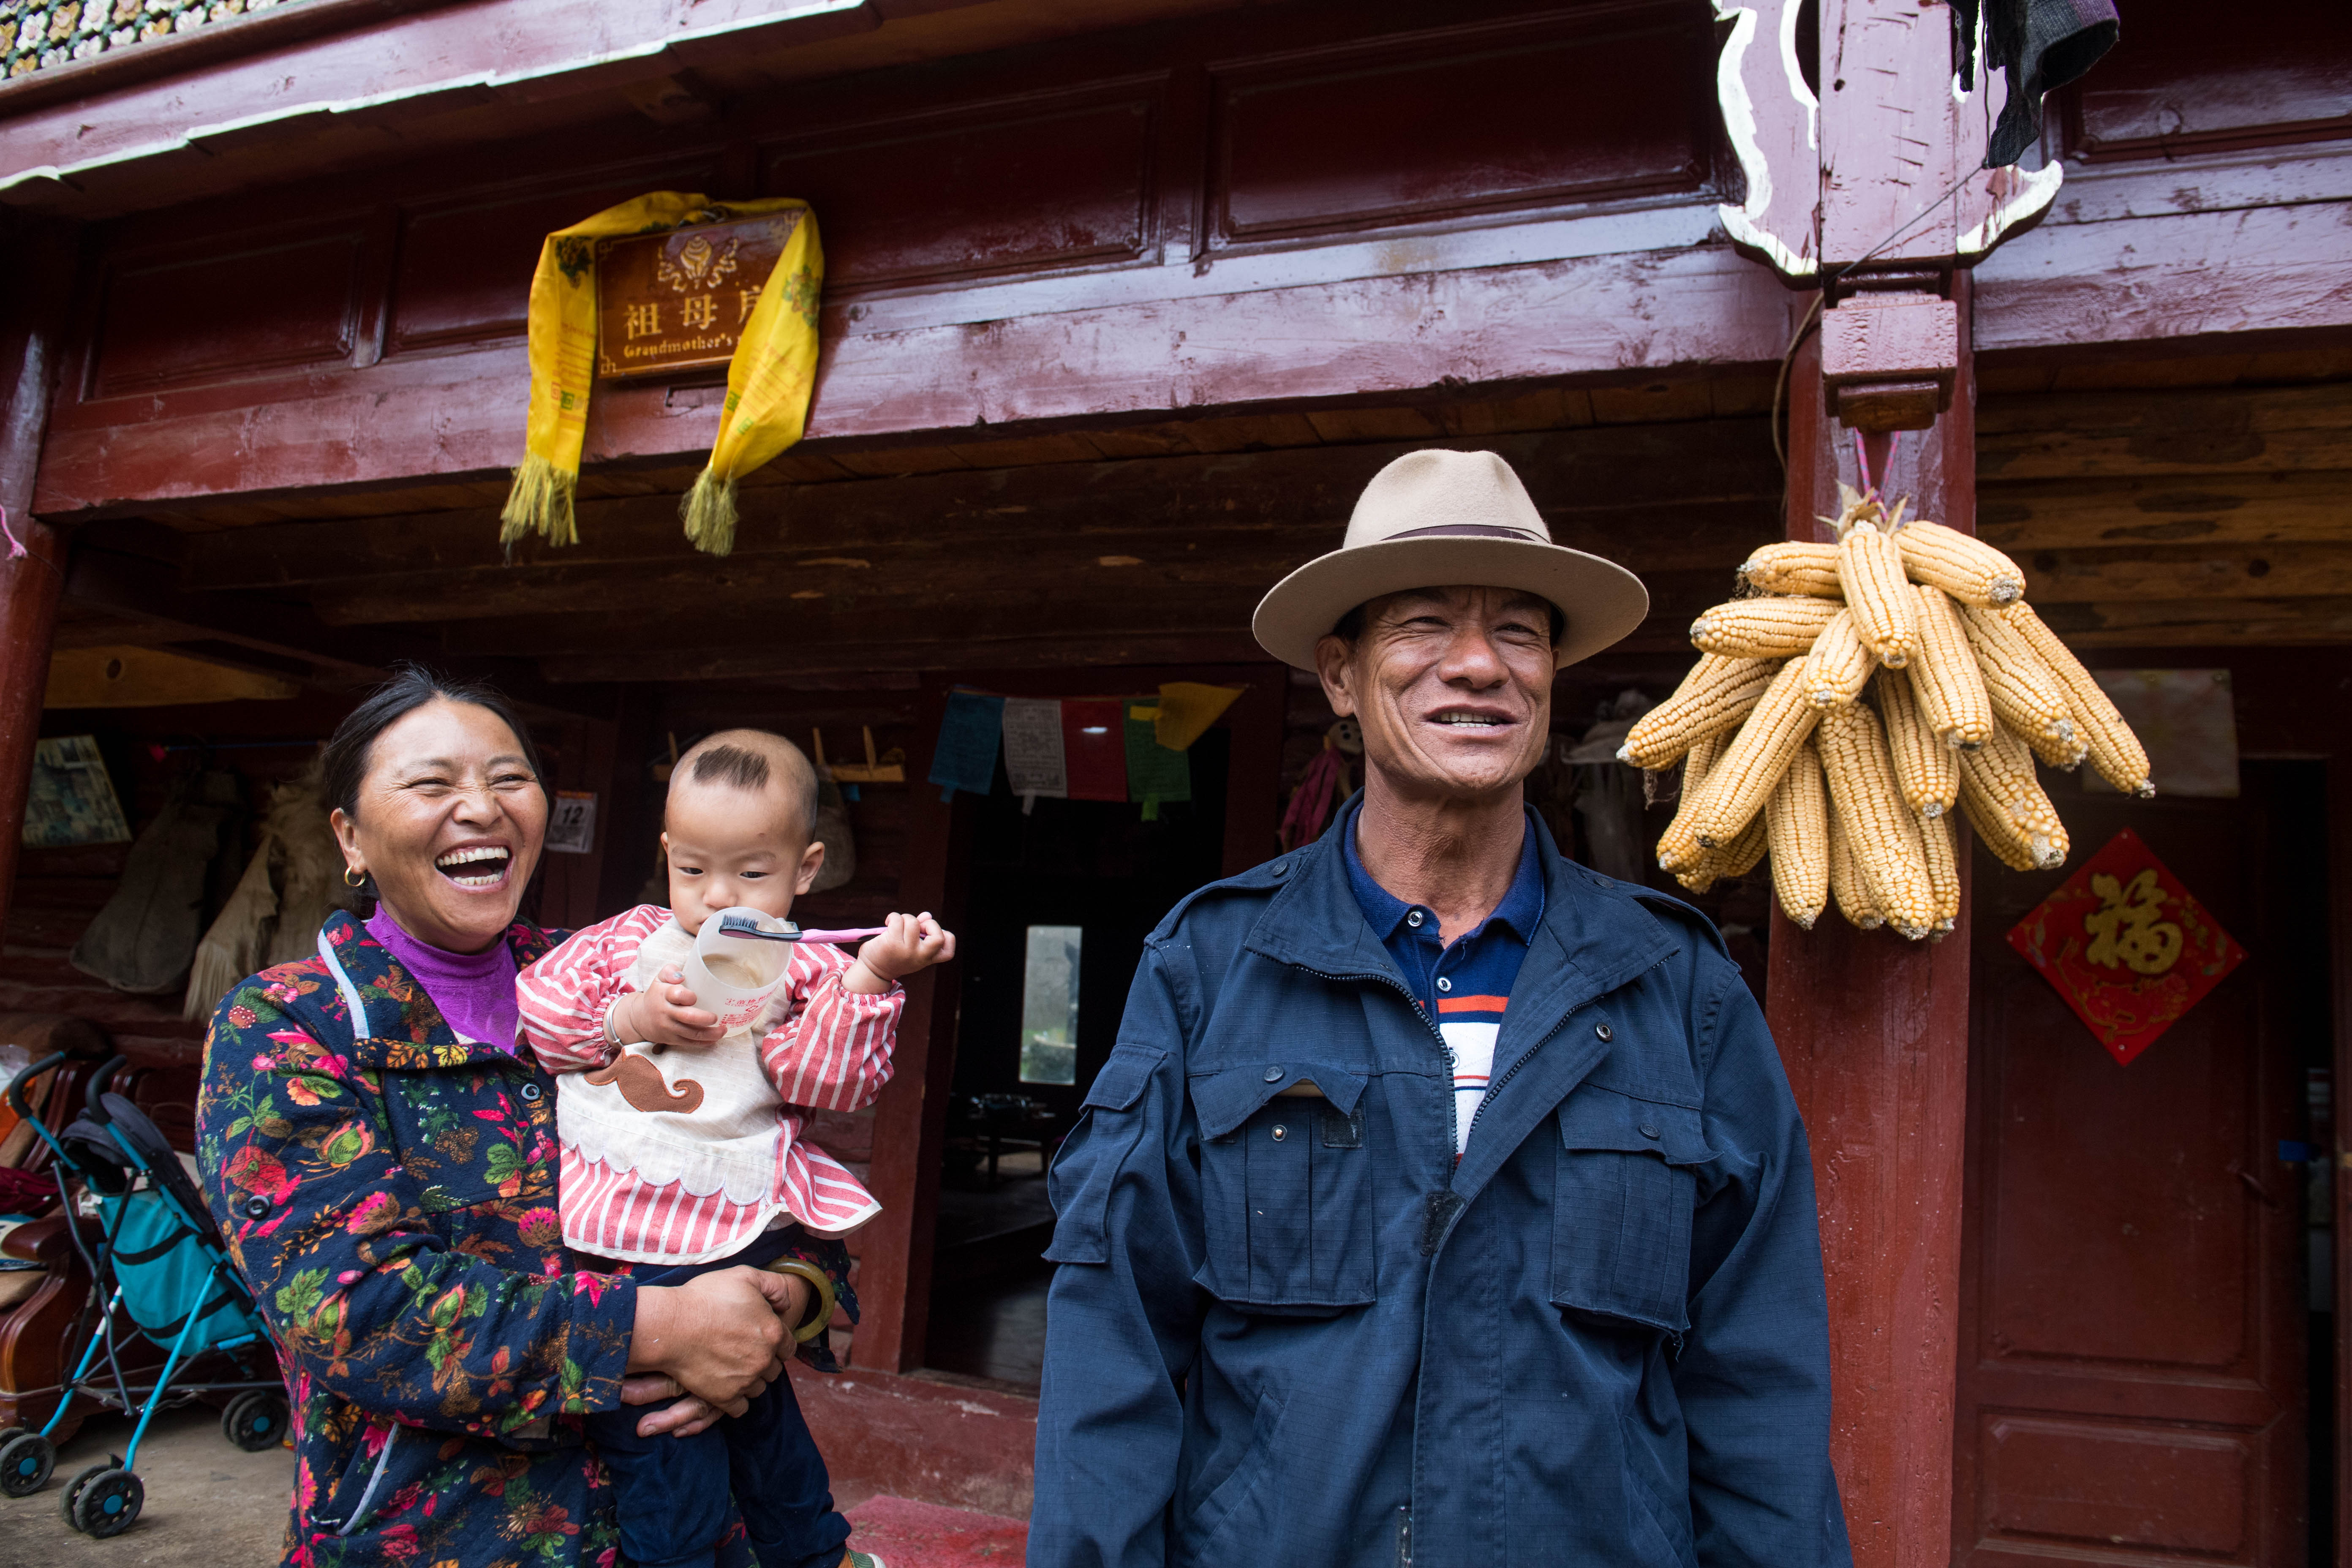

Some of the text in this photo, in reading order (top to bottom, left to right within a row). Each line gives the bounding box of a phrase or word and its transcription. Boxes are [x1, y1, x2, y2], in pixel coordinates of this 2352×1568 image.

[623, 333, 733, 359] Grandmother's
[563, 805, 583, 824] 12
[2084, 868, 2183, 975] 福
